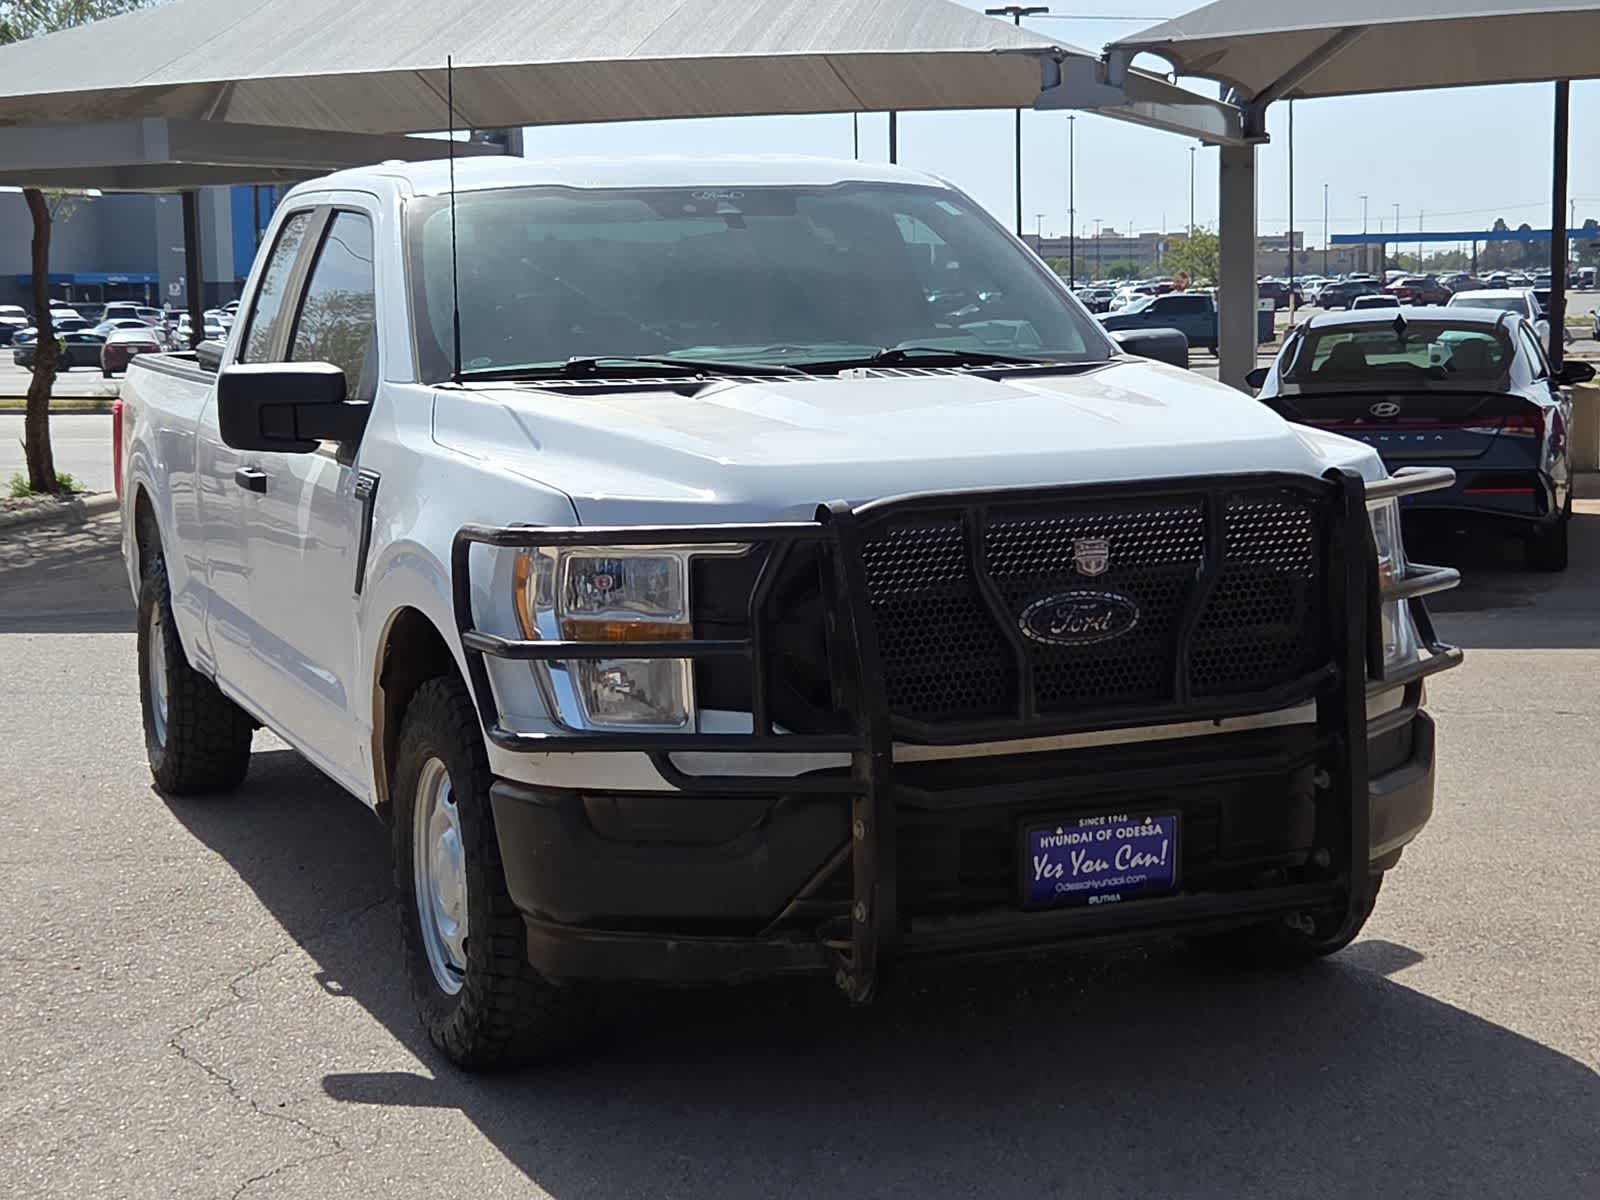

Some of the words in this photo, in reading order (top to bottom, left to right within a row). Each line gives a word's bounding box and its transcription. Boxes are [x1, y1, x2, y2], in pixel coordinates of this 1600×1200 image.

[1050, 603, 1113, 633] Ford
[1079, 816, 1105, 828] SINCE
[1040, 831, 1093, 849] HYUNDAI
[1095, 828, 1113, 842] OF
[1115, 823, 1163, 839] ODESSA
[1033, 853, 1064, 881] Yes
[1070, 848, 1110, 877] You
[1115, 839, 1169, 871] Can!
[1055, 873, 1148, 893] OdessaHyundai.com
